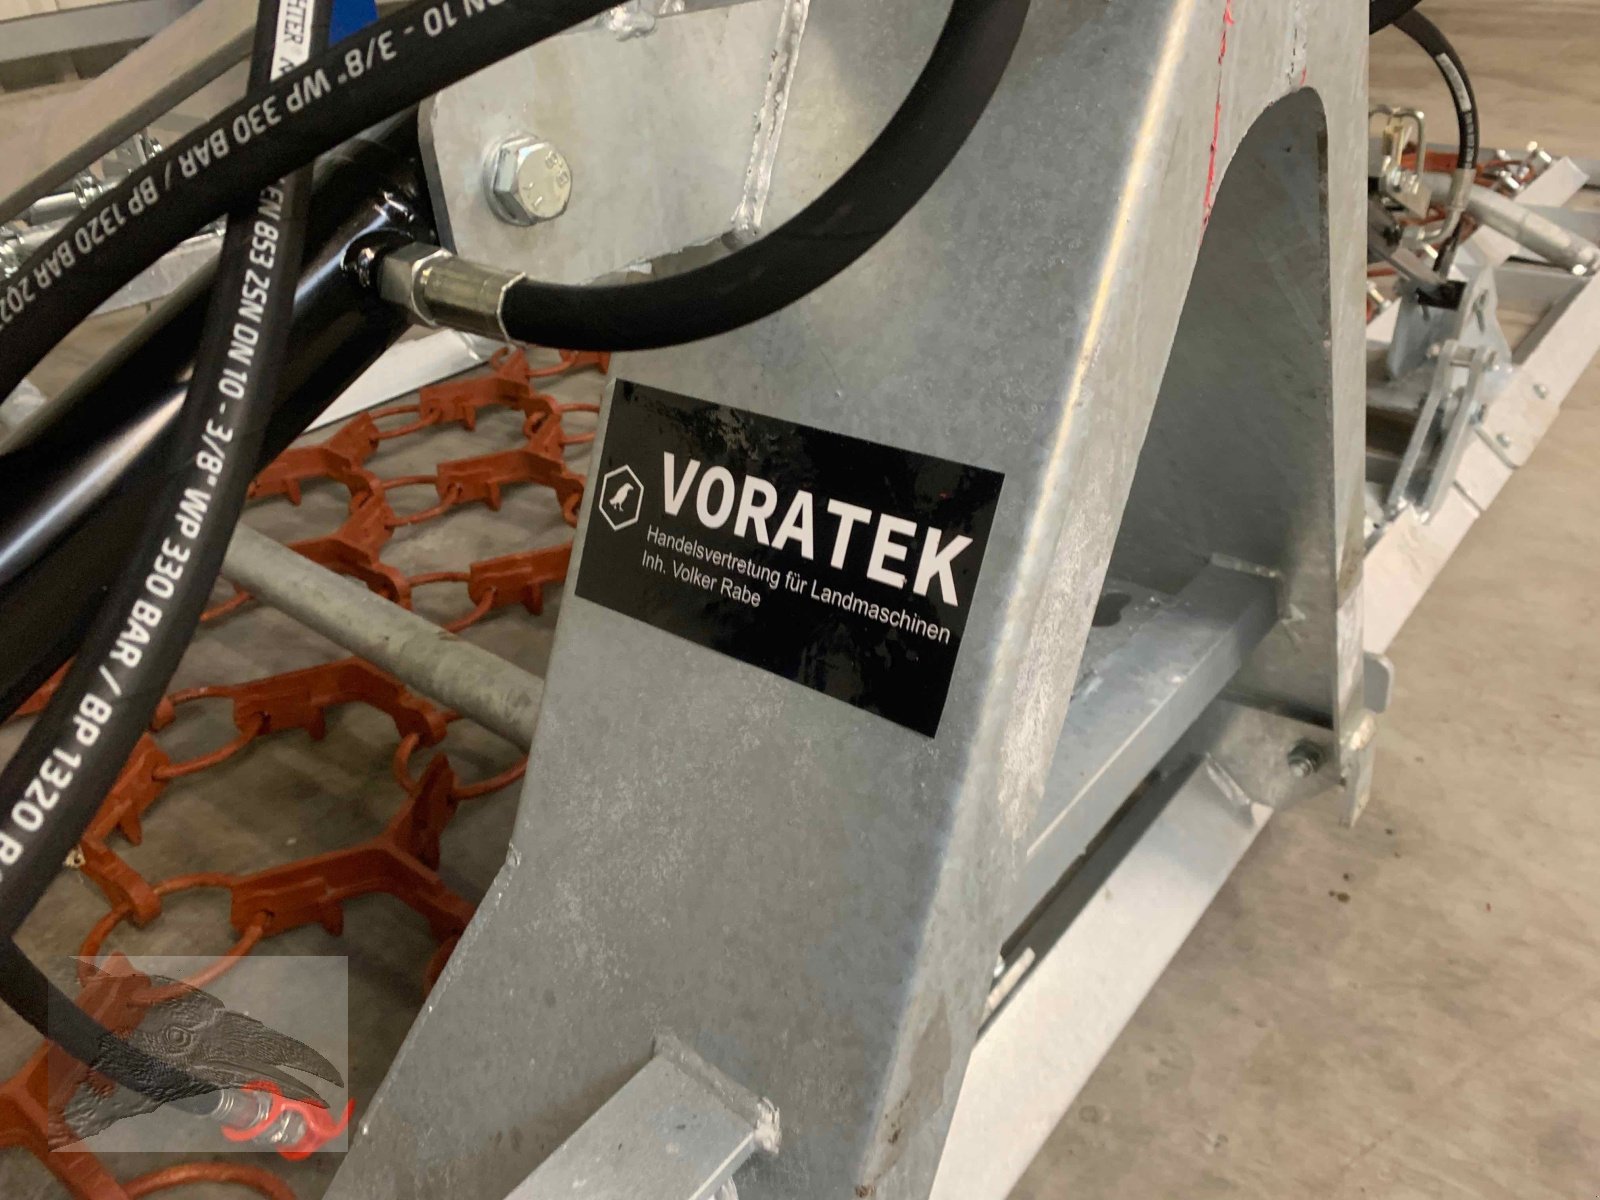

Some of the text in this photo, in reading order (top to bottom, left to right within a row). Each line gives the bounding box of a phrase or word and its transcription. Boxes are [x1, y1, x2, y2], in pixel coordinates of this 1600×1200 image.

[423, 2, 458, 37] 10
[463, 0, 501, 19] N
[286, 68, 331, 112] WP
[232, 95, 282, 144] 330
[164, 160, 172, 191] /
[177, 128, 230, 178] BAR
[128, 176, 159, 215] BP
[258, 186, 284, 221] EN
[75, 203, 126, 254] 1320
[250, 220, 279, 269] 853
[33, 240, 76, 289] BAR
[238, 269, 271, 323] 2SN
[227, 322, 259, 366] DN
[218, 368, 248, 400] 10
[175, 488, 212, 540] WP
[661, 450, 975, 608] VORATEK
[145, 537, 191, 599] 330
[642, 550, 761, 608] Inh. Volker Rabe
[646, 524, 951, 645] Handelsvertretung für Landmaschinen
[109, 598, 163, 668] BAR
[99, 664, 123, 696] /
[72, 693, 113, 747] BP
[11, 747, 82, 832] 1320
